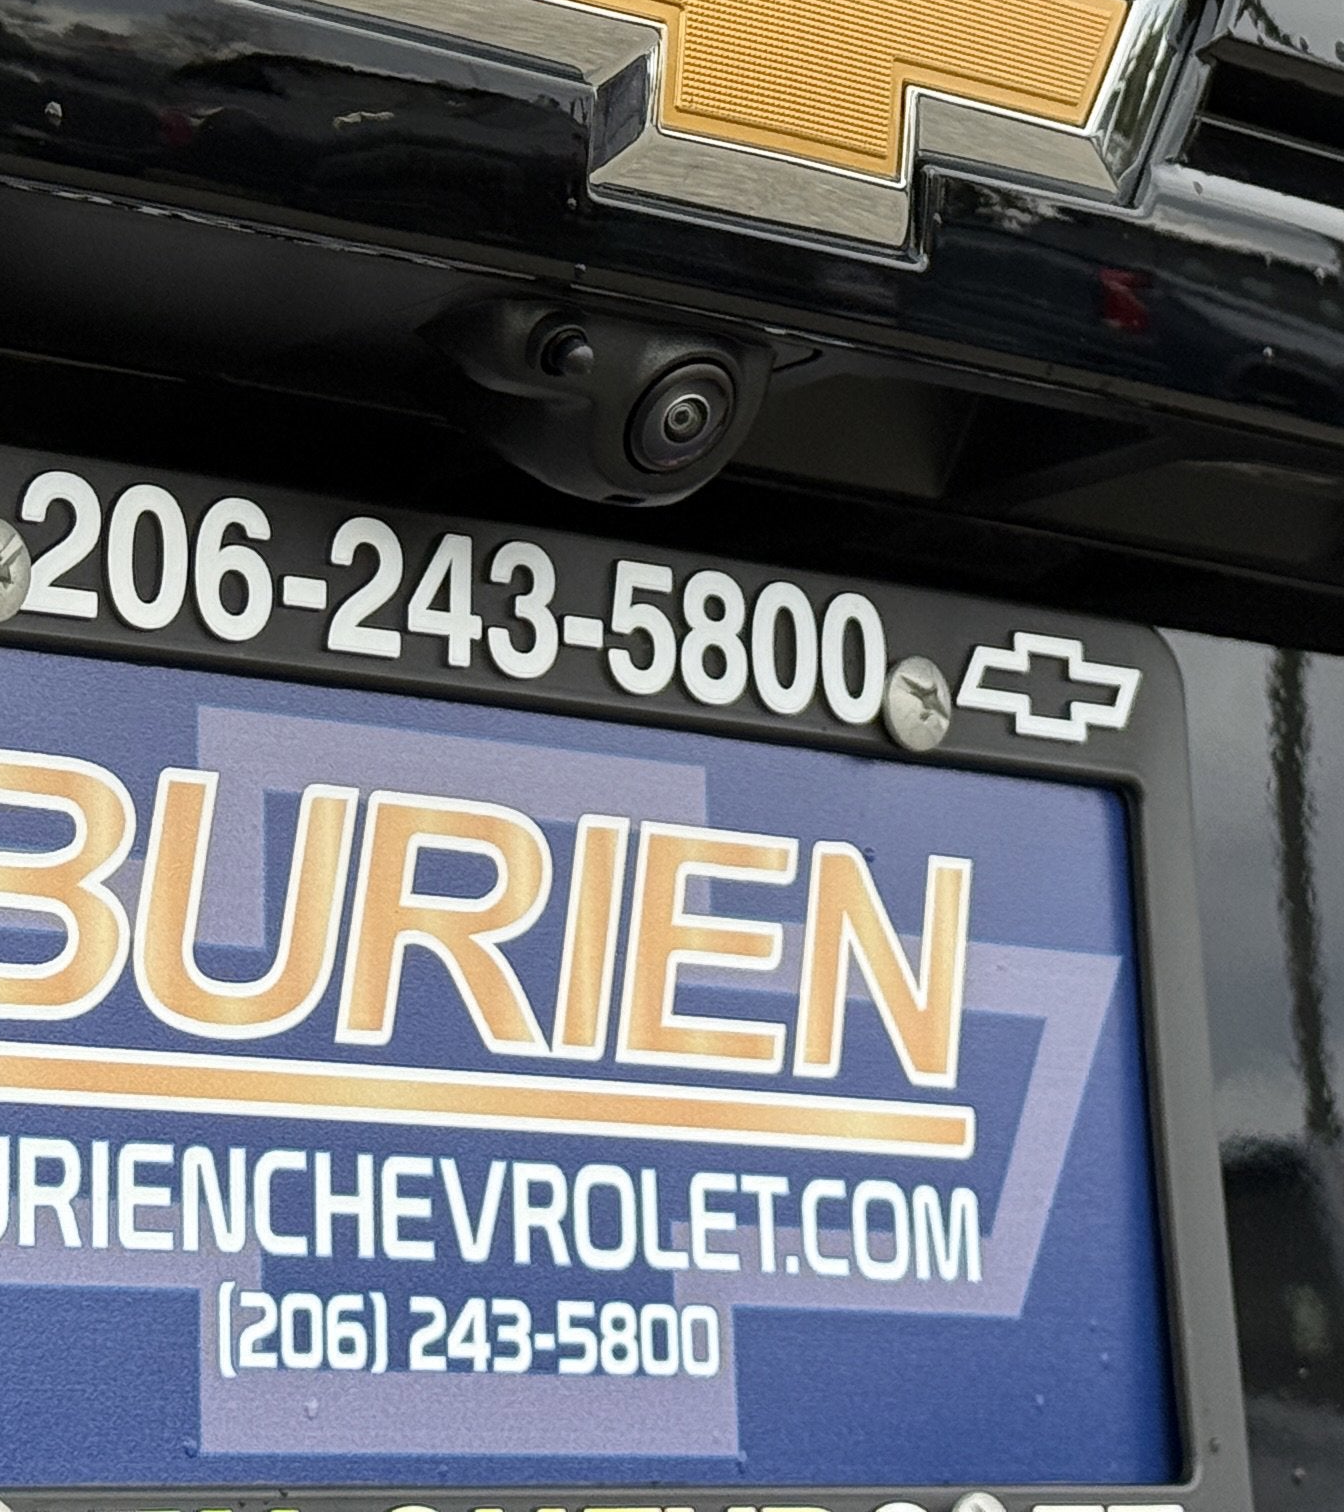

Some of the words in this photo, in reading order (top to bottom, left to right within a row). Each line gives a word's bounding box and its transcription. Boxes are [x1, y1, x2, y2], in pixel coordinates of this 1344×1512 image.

[20, 469, 888, 726] 206-243-5800
[218, 1280, 388, 1378] (206)
[408, 1295, 721, 1377] 243-5800
